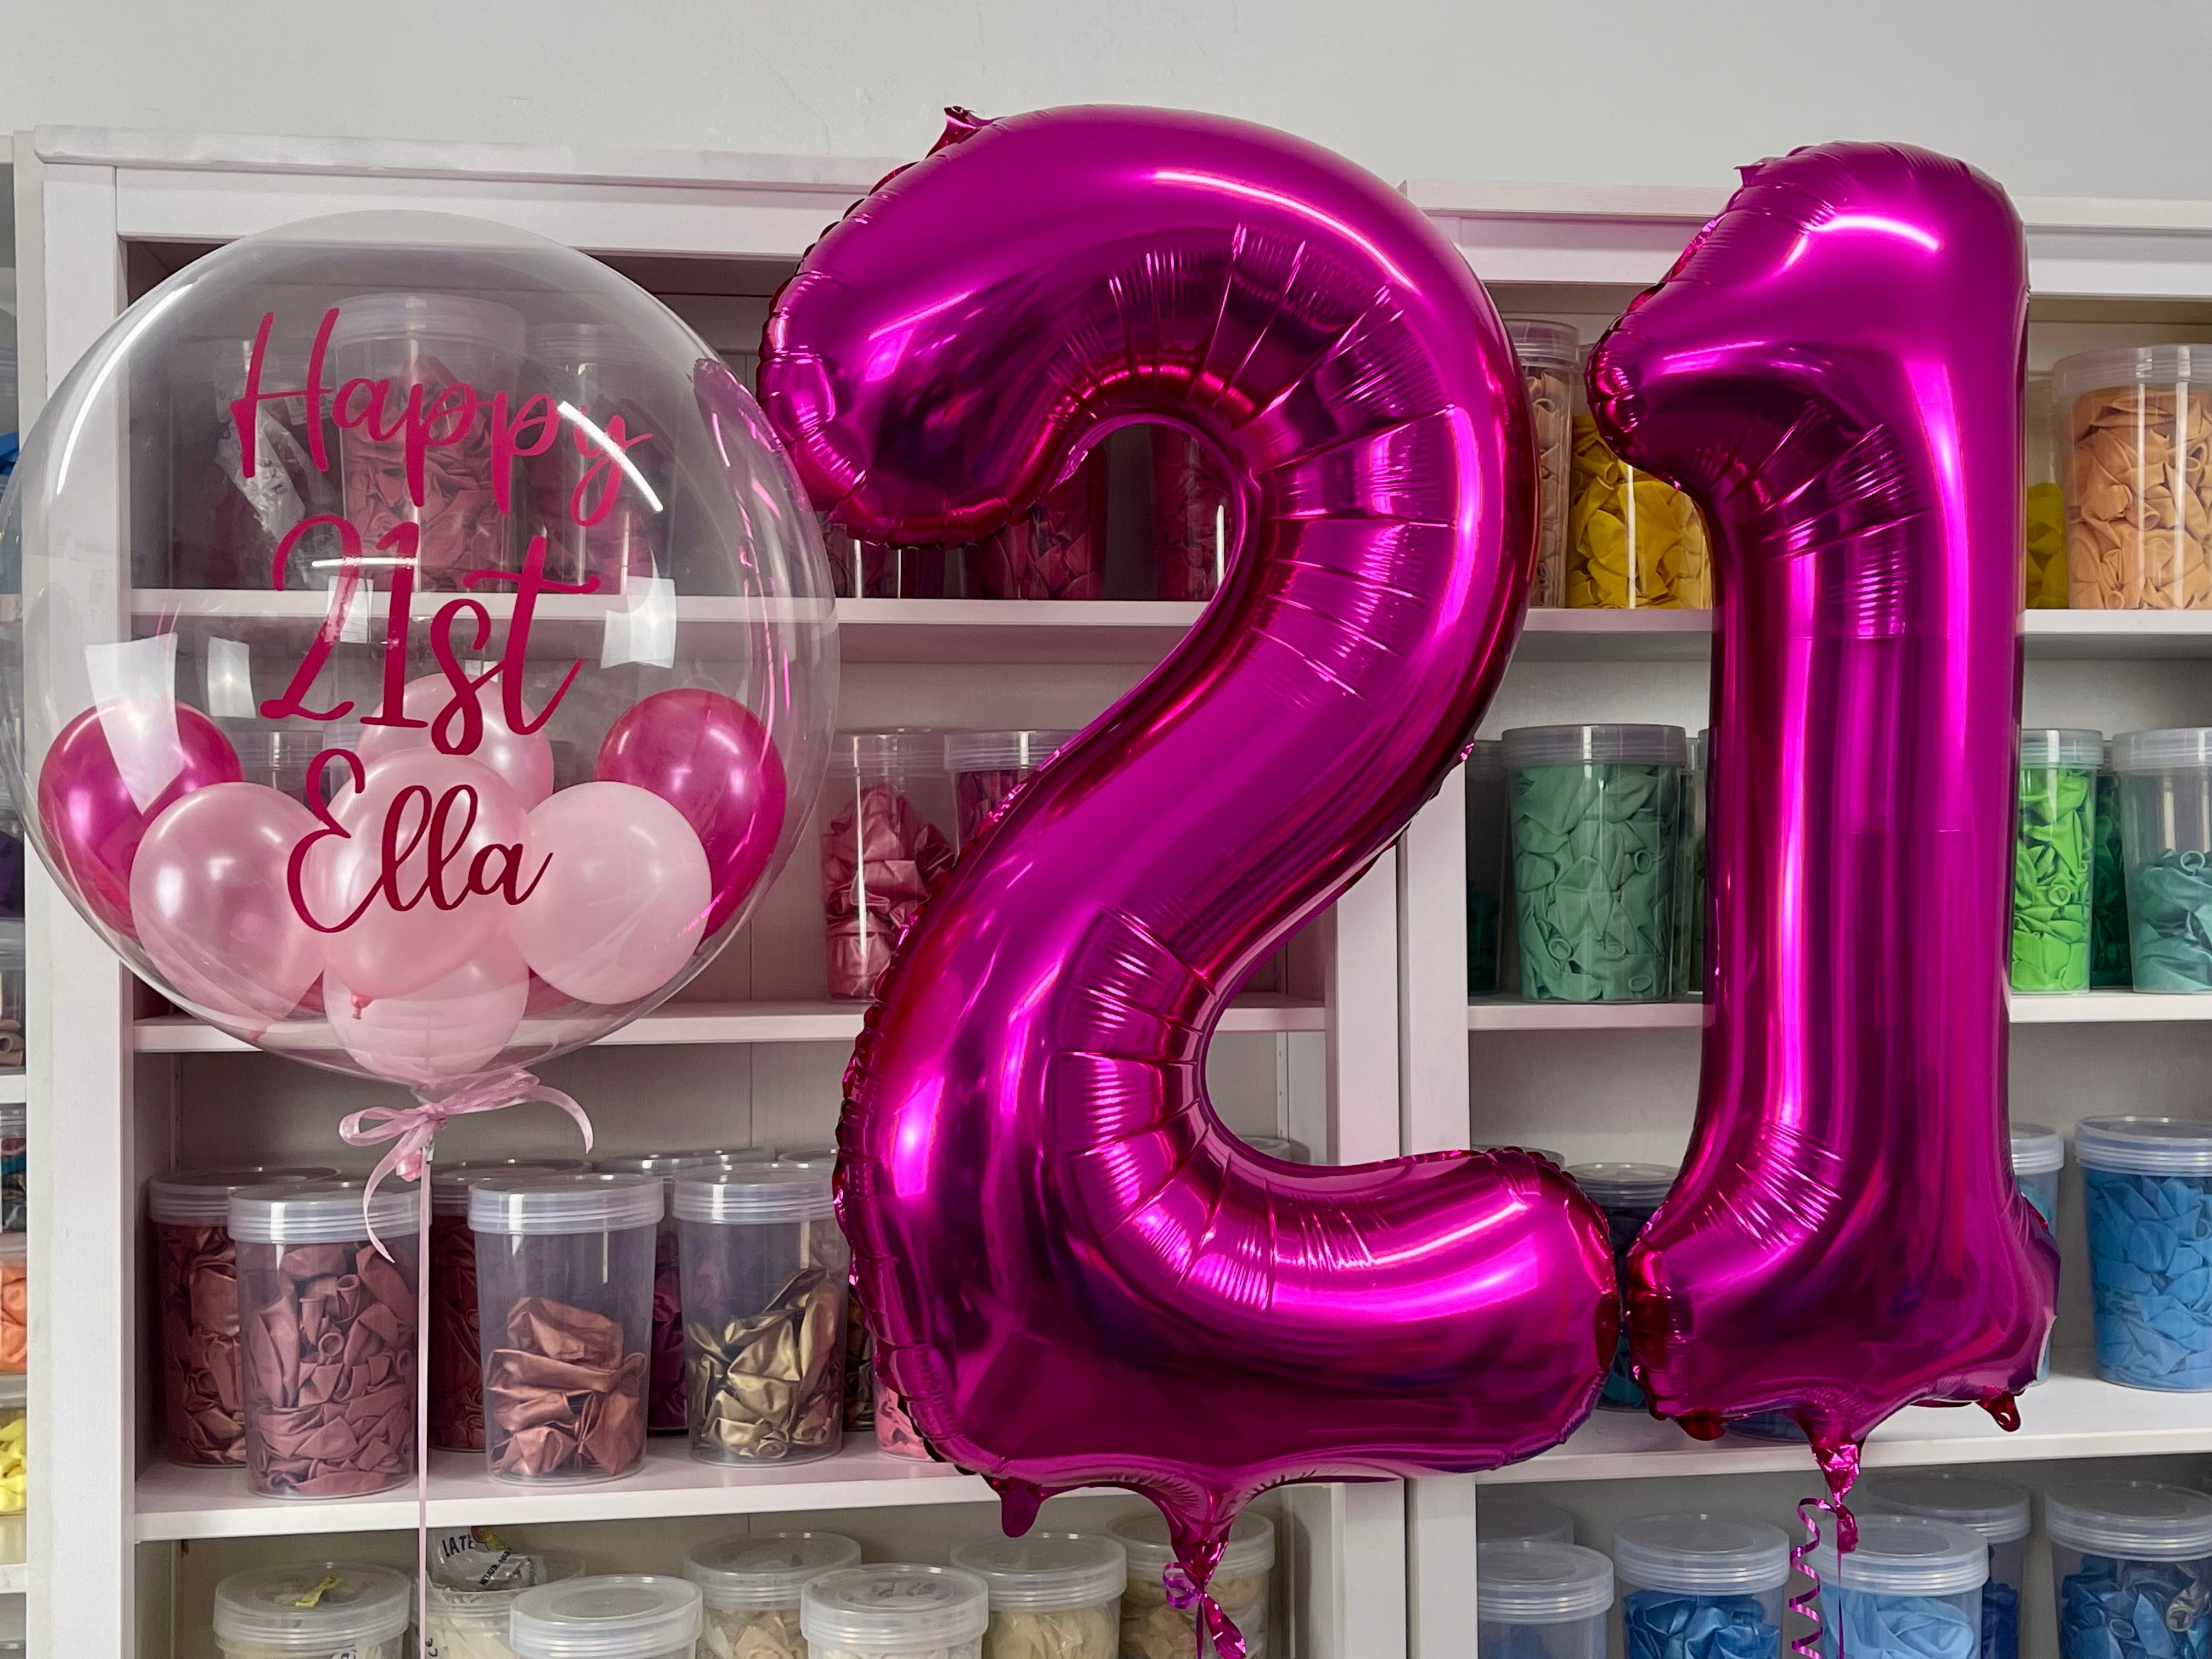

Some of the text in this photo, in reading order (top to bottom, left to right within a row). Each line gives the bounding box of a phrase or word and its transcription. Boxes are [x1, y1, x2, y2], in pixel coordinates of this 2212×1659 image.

[230, 307, 653, 527] Happy
[259, 514, 602, 756] 21st
[286, 748, 553, 933] Ella
